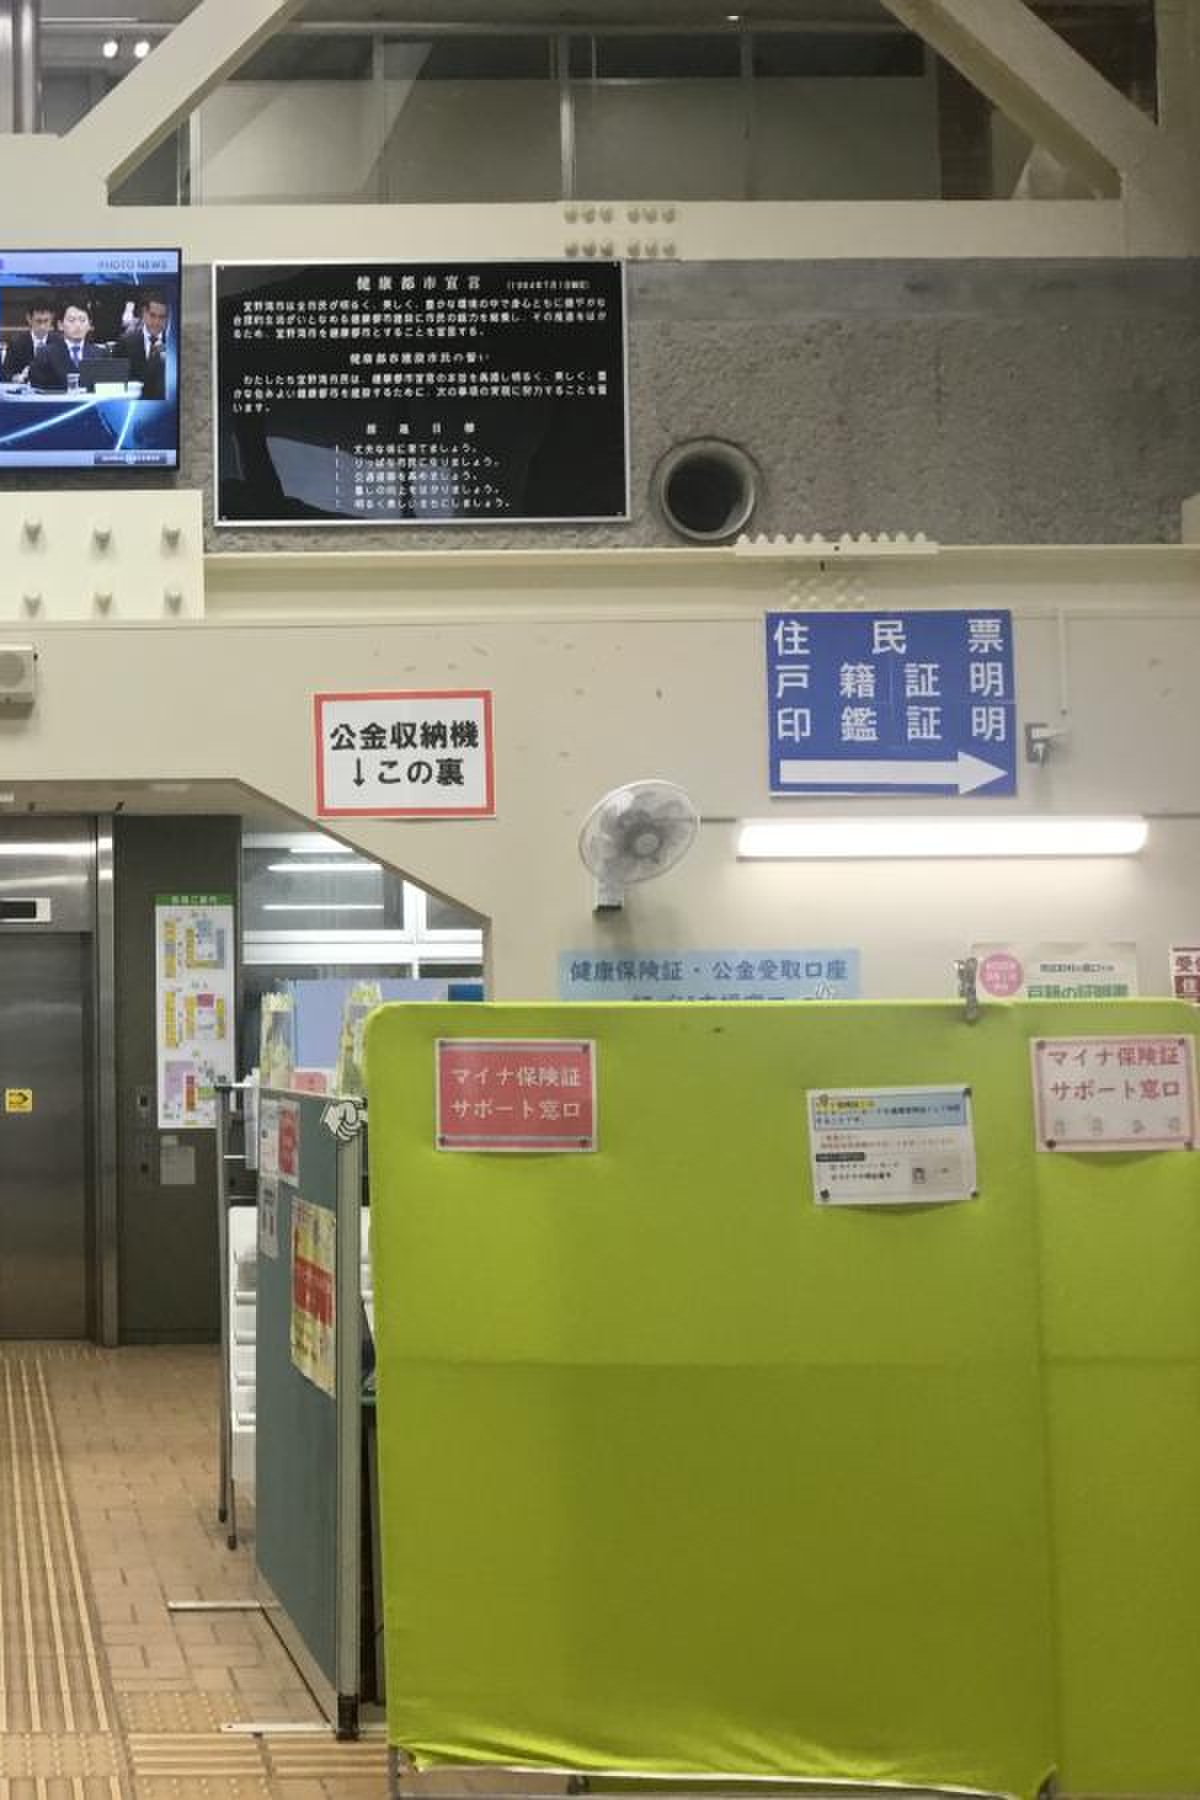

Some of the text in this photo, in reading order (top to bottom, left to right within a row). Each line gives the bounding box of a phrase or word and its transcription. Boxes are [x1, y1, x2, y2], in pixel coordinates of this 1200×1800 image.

[773, 619, 1003, 655] 住民票
[775, 661, 1005, 698] 戸籍証明
[777, 706, 1006, 742] 印鑑証明
[330, 720, 479, 750] 公金収納機
[1175, 955, 1200, 973] 受
[1048, 1047, 1181, 1067] マイナ保険証
[451, 1066, 582, 1087] マイナ保険証
[1050, 1080, 1181, 1100] サポート窓口
[450, 1099, 581, 1120] サポート窓口
